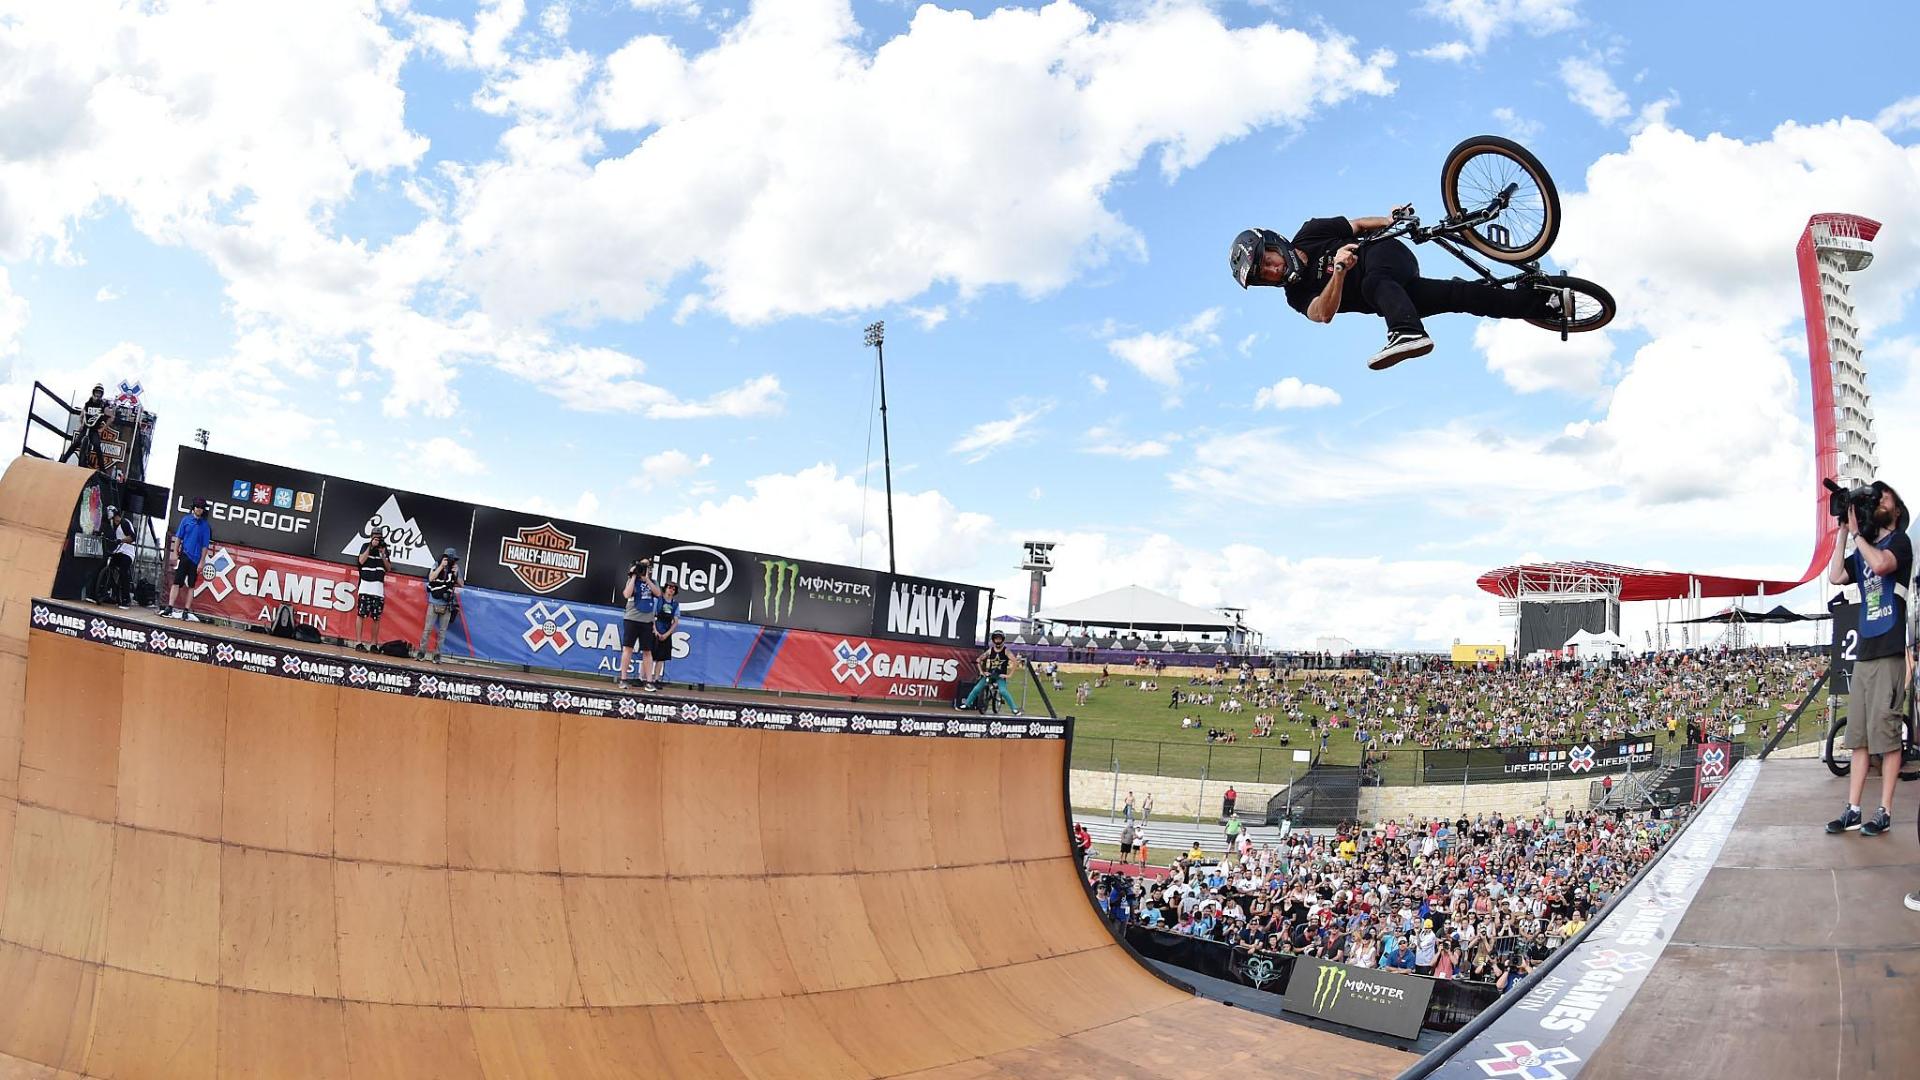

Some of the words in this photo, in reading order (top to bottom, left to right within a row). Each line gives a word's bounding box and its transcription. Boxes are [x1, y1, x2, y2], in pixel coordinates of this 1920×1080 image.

[177, 495, 310, 534] LEPROOF
[527, 531, 566, 549] MOTOR
[507, 545, 580, 570] HARLEY-DAVIDSON
[522, 566, 561, 586] CYCLES
[651, 555, 717, 593] intel
[234, 564, 356, 612] GAMES
[809, 594, 860, 604] ENERGY
[48, 613, 86, 631] GAMES
[258, 605, 327, 631] ATIN
[56, 627, 78, 637] AUSTIN
[106, 626, 146, 643] GAMES
[576, 620, 691, 658] GAS
[114, 640, 138, 650] AUSTIN
[167, 638, 208, 654] GAMES
[175, 652, 200, 662] AUSTIN
[234, 650, 276, 668] GAMES
[242, 664, 267, 674] AUSTIN
[300, 662, 344, 678] GAMES
[872, 653, 960, 683] GAMES
[310, 674, 335, 684] AUSTIN
[368, 671, 412, 688] GAMES
[376, 685, 402, 694] AUSTIN
[438, 681, 481, 696] GAMES
[889, 682, 938, 698] AUSTIN
[446, 694, 472, 702] AUSTIN
[505, 689, 548, 704] GAMES
[571, 696, 612, 710] GAMES
[514, 702, 539, 710] AUSTIN
[579, 708, 604, 716] AUSTIN
[636, 702, 676, 716] GAMES
[644, 714, 668, 722] AUSTIN
[698, 708, 736, 720] GAMES
[756, 712, 792, 724] GAMES
[814, 716, 848, 728] GAMES
[865, 720, 898, 730] GAMES
[914, 722, 942, 731] GAMES
[960, 724, 986, 732] GAMES
[1001, 724, 1027, 733] GAMES
[1040, 726, 1064, 734] GAMES
[1504, 762, 1566, 773] LIFEPROOF
[1518, 976, 1567, 1011] AUSTIN
[1540, 970, 1624, 1033] GAMES
